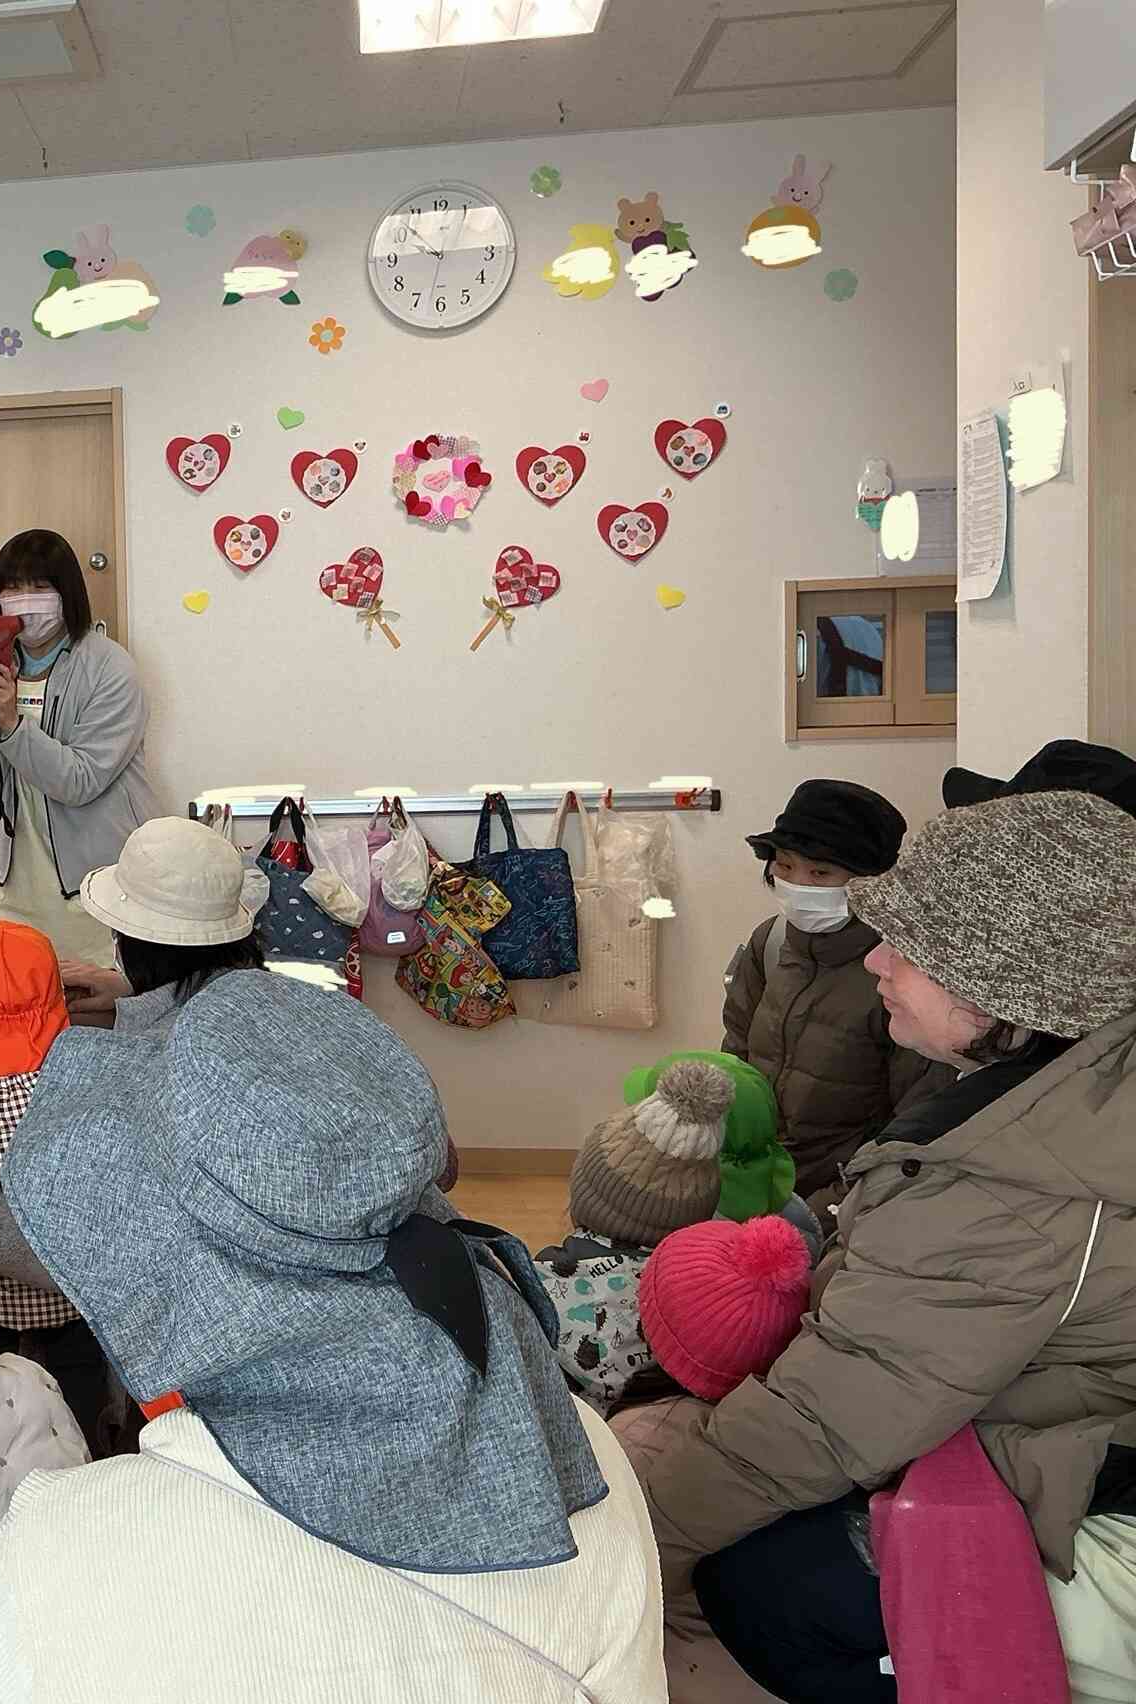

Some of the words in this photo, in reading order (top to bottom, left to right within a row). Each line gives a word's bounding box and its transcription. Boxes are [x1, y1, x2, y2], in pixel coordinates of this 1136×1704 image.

[387, 252, 398, 268] 9
[483, 245, 495, 261] 3
[393, 275, 405, 291] 8
[475, 269, 486, 285] 4
[411, 292, 422, 308] 7
[435, 296, 446, 312] 6
[460, 289, 471, 305] 5
[588, 1254, 624, 1279] HELLO
